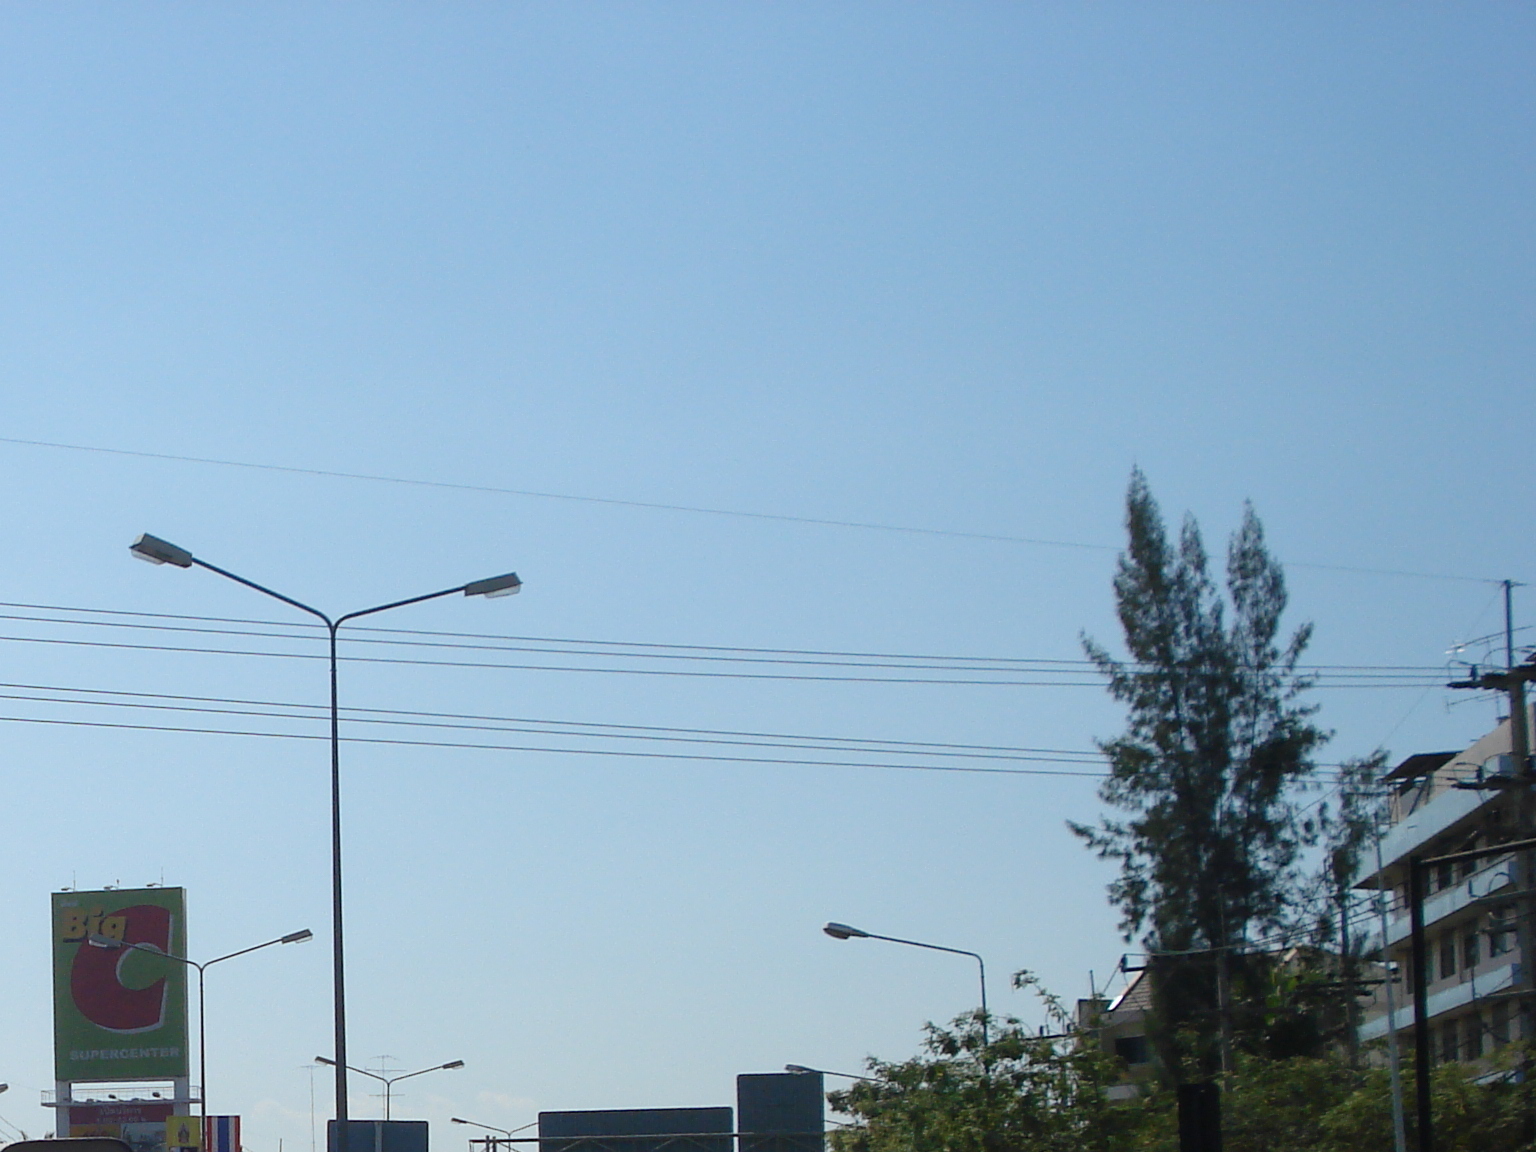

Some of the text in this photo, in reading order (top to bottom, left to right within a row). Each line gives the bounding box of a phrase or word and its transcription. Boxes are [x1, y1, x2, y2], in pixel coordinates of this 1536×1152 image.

[62, 904, 128, 943] Big
[70, 904, 173, 1034] C
[69, 1046, 180, 1061] SUPERCENTER
